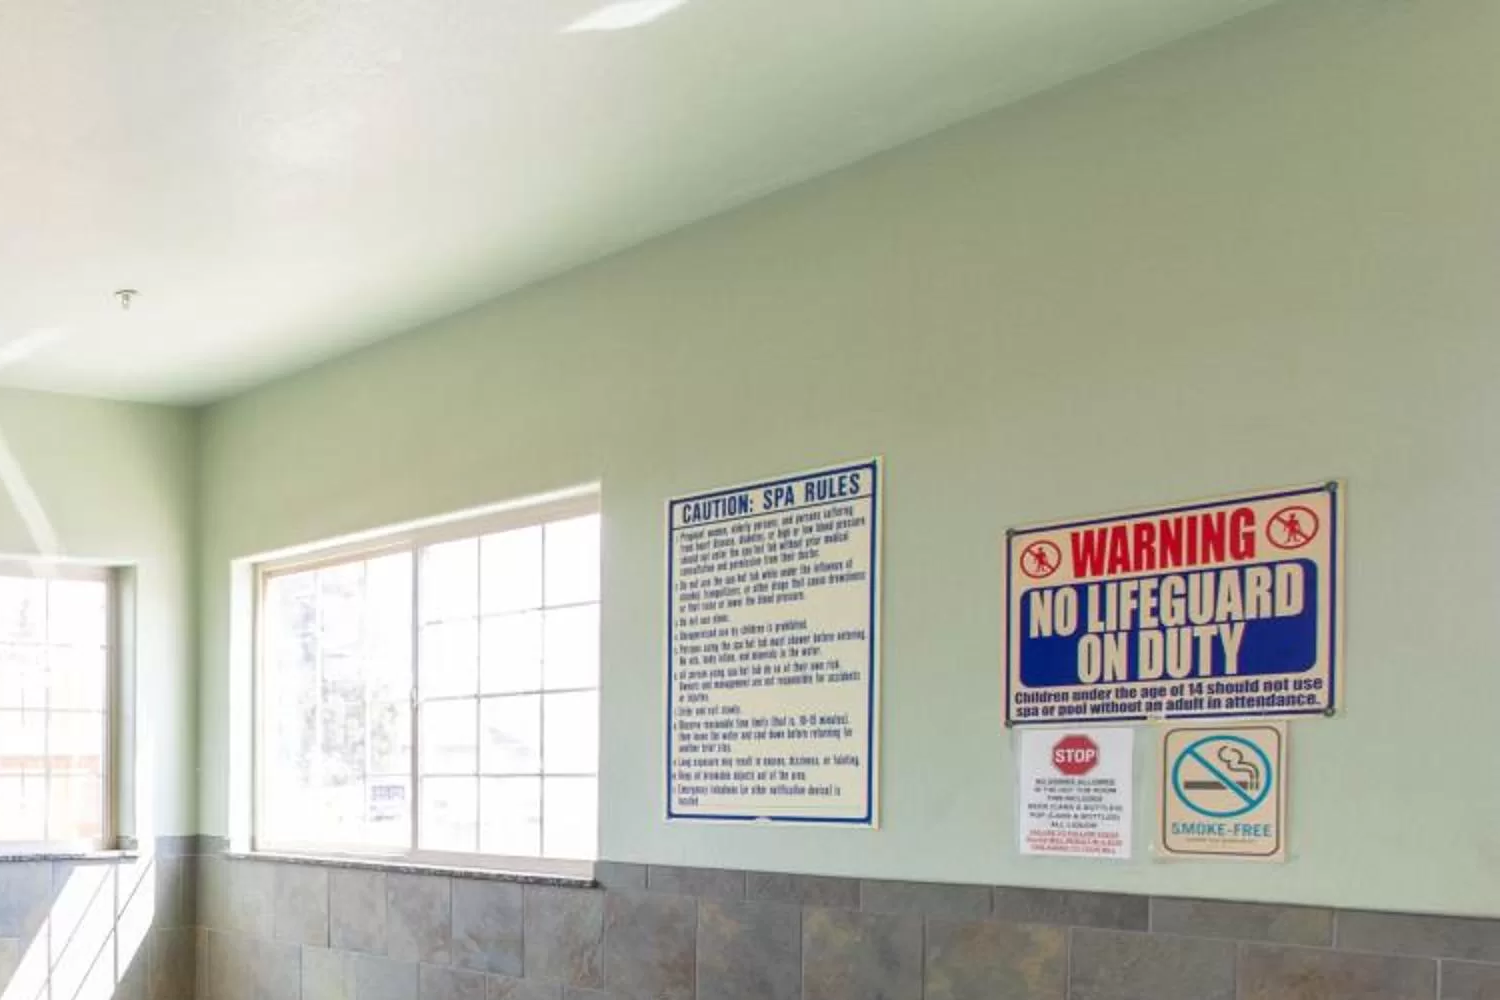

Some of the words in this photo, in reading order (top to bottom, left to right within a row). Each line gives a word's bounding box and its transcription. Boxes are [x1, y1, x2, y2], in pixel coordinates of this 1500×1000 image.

[682, 494, 754, 524] CAUTION:
[763, 487, 795, 510] SPA
[804, 472, 861, 502] RULES
[1070, 507, 1256, 579] WARNING
[1028, 587, 1078, 638] NO
[1087, 564, 1304, 631] LIFEGUARD
[1077, 630, 1130, 683] ON
[1138, 621, 1247, 679] DUTY
[1015, 691, 1069, 705] Children
[1073, 690, 1111, 702] under
[1115, 687, 1137, 700] the
[1140, 686, 1165, 699] age
[1169, 684, 1184, 697] of
[1188, 682, 1203, 695] 14
[1206, 681, 1259, 694] should
[1263, 679, 1289, 692] not
[1292, 678, 1322, 691] use
[1016, 706, 1039, 717] spa
[1042, 705, 1055, 716] or
[1058, 704, 1087, 717] pool
[1090, 700, 1142, 713] without
[1145, 701, 1162, 711] an
[1166, 697, 1205, 711] adult
[1207, 696, 1221, 708] in
[1225, 693, 1320, 708] attendance.
[1055, 748, 1095, 763] STOP
[1172, 822, 1272, 837] SMOKE-FREE
